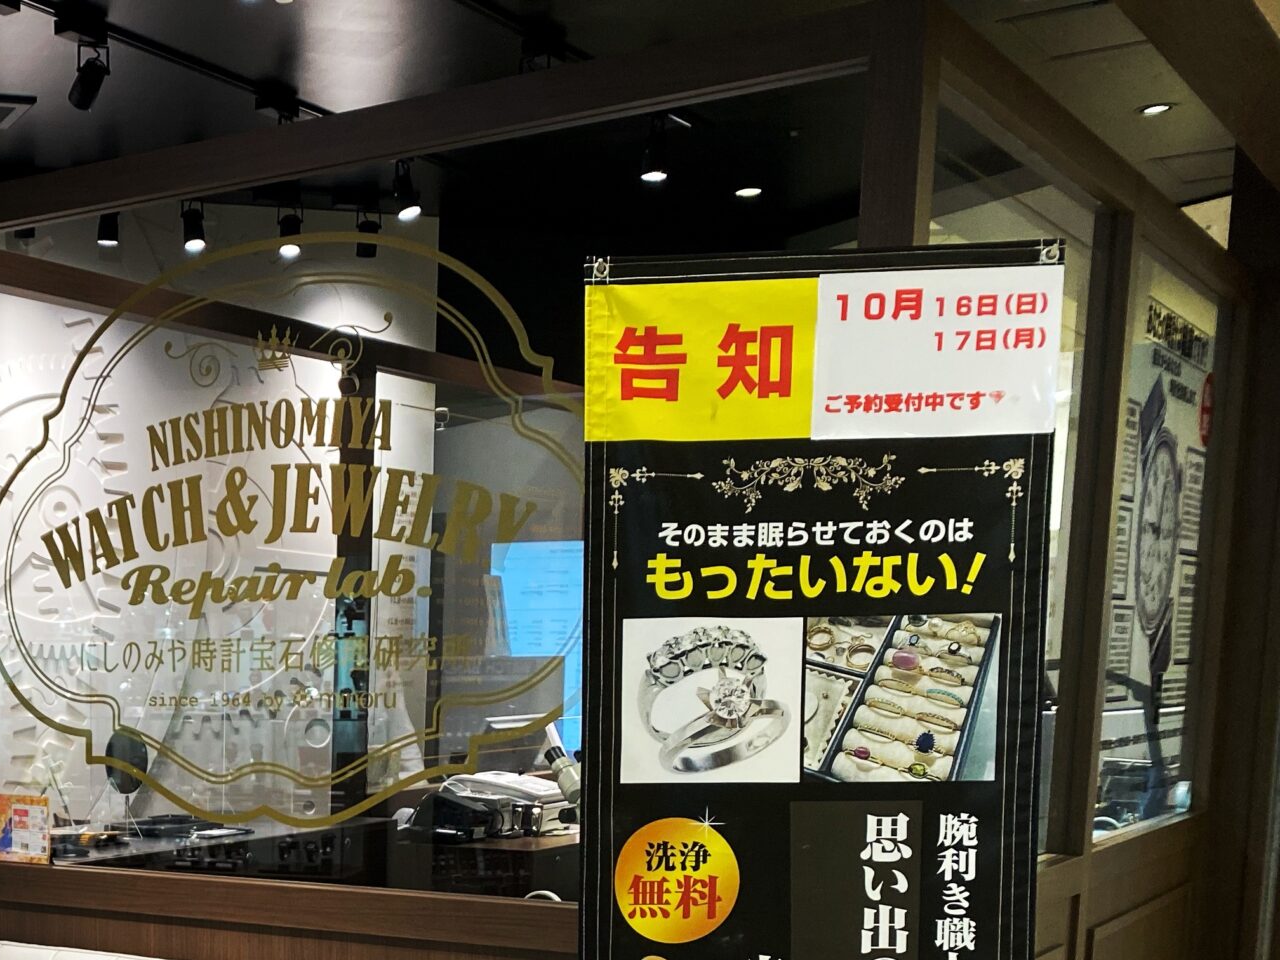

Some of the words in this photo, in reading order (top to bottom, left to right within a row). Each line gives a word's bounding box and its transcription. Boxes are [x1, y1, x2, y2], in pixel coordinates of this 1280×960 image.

[835, 288, 925, 322] 10月
[934, 328, 1048, 351] 17日(月)
[613, 323, 794, 402] 告知
[824, 391, 988, 414] ご予約受付中です
[147, 397, 392, 472] NISHINOMIYA
[41, 474, 209, 591] WATCH
[220, 466, 260, 537] &
[264, 463, 539, 566] JEWELRY
[658, 518, 975, 548] そのまま眠らせておくのは
[121, 563, 332, 620] Repair
[323, 555, 433, 599] lab.
[646, 551, 988, 601] もったいない!
[148, 693, 199, 707] since
[644, 840, 712, 872] 洗浄
[627, 874, 723, 920] 無料
